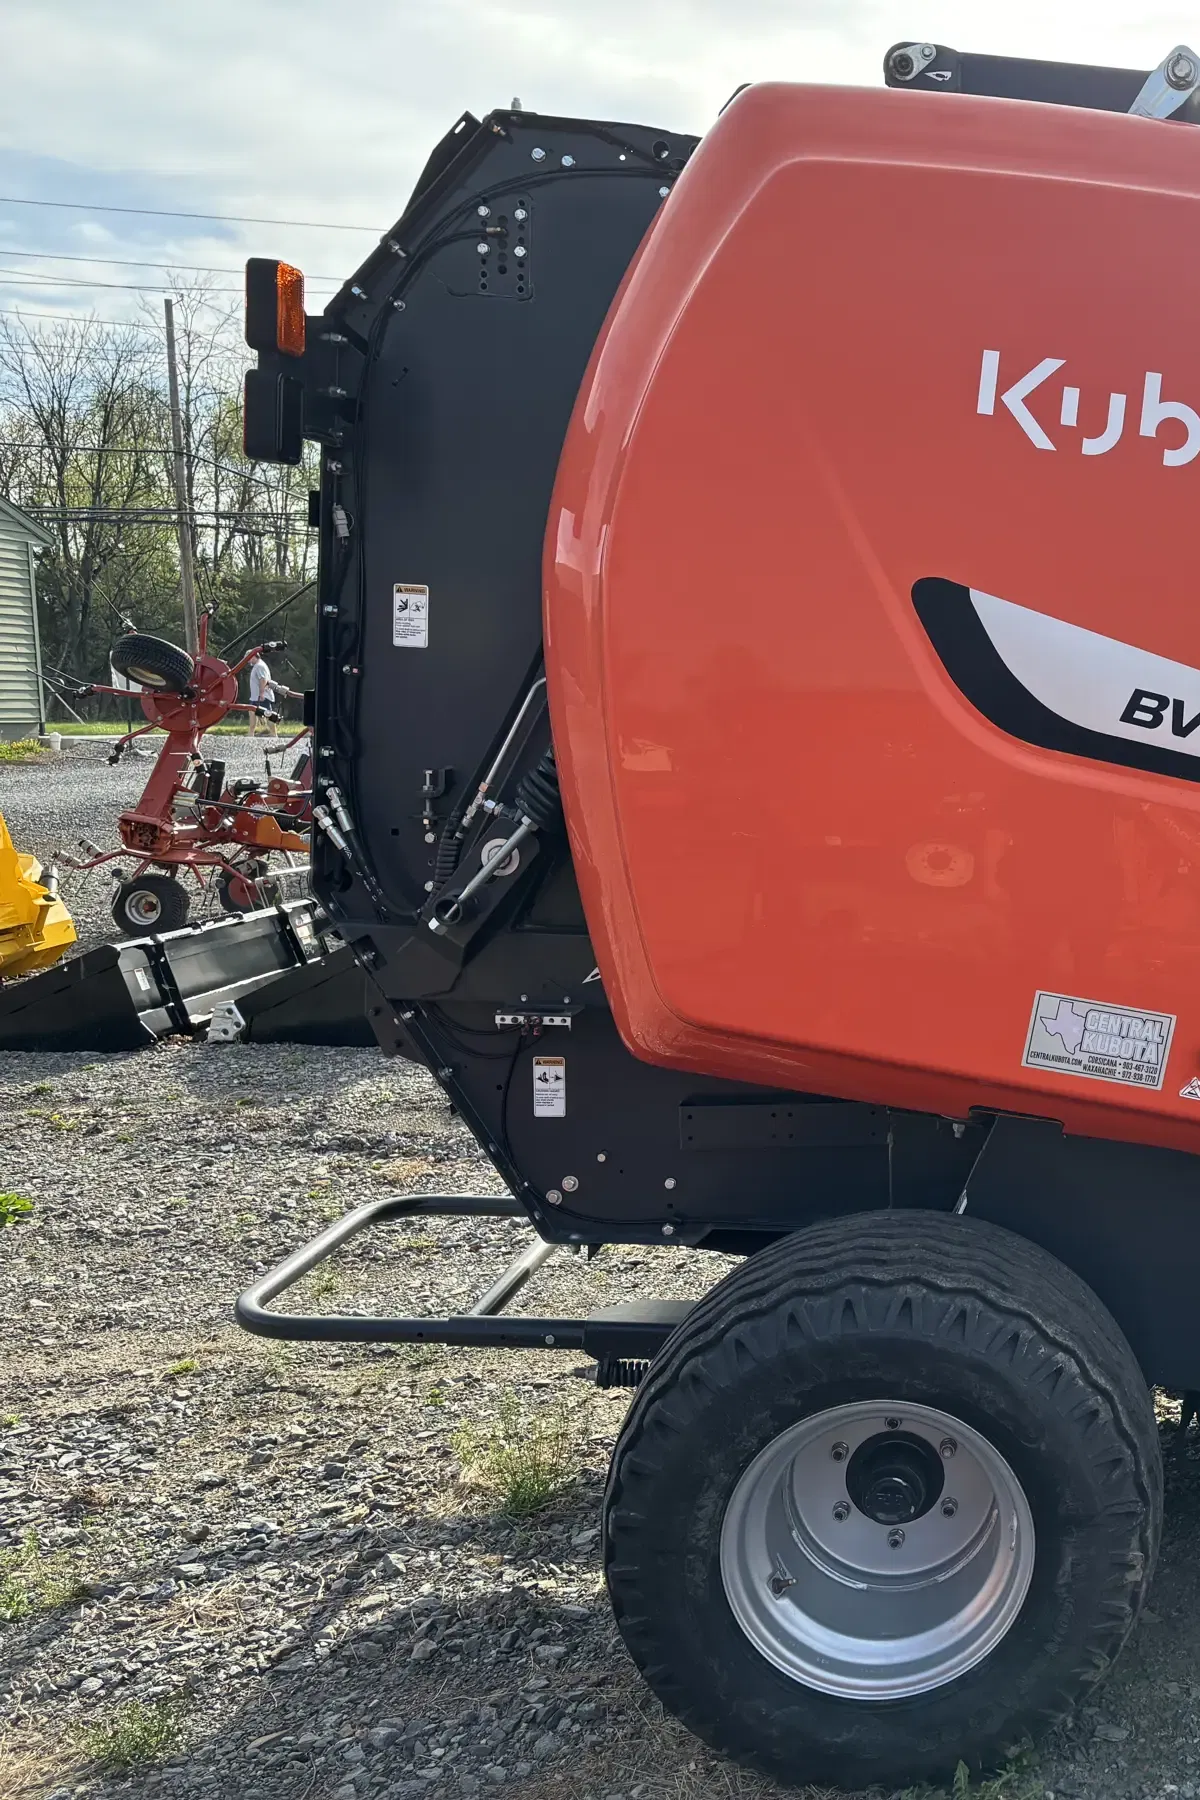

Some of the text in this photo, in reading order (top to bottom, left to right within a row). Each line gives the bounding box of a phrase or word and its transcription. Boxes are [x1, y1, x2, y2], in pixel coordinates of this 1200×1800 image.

[1086, 1010, 1163, 1043] CENTRAL
[1081, 1031, 1158, 1064] KUBOTA
[1029, 1051, 1083, 1067] CENTRALKUBOTA.COM
[1087, 1055, 1118, 1068] CORSICANA
[1082, 1063, 1117, 1077] WAXAHACHIE
